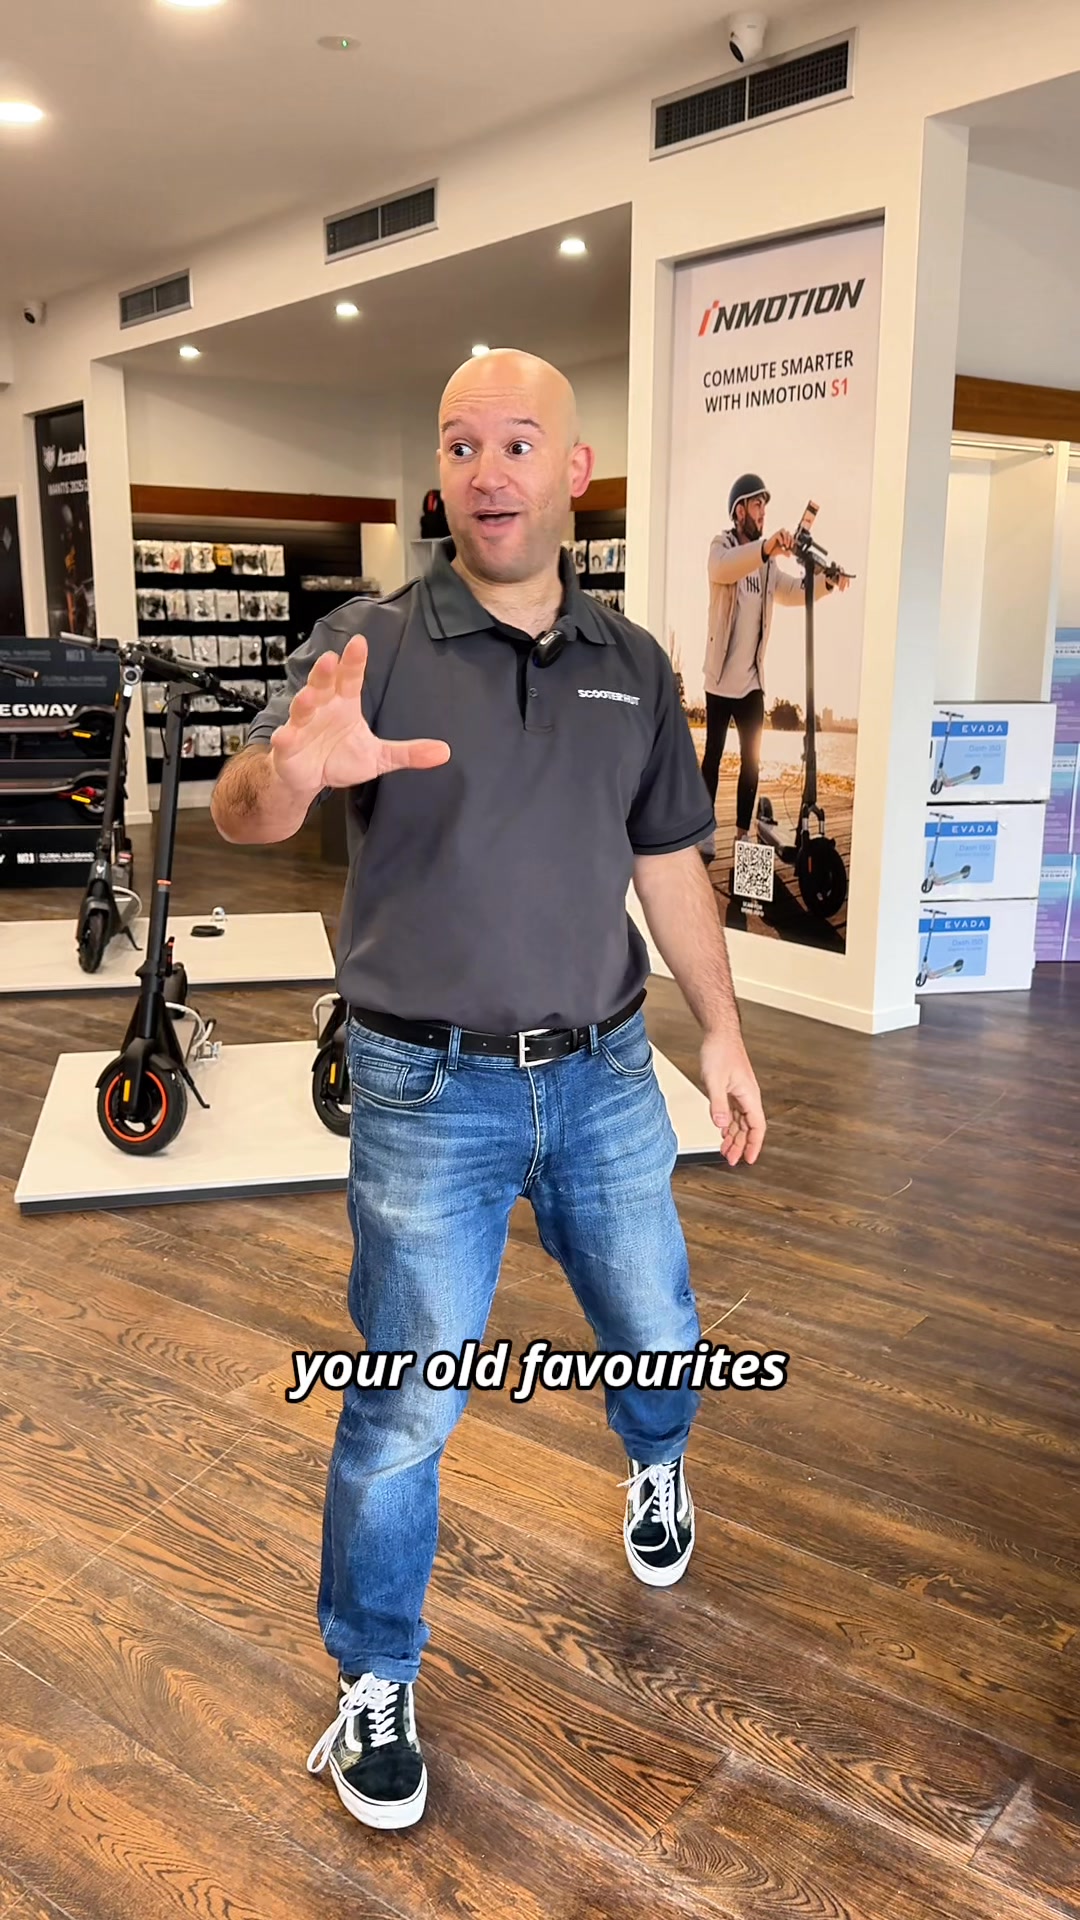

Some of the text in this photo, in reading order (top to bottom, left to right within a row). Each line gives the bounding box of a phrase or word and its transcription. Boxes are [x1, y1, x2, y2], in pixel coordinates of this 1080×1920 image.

[703, 350, 854, 388] COMMUTE SMARTER
[705, 378, 848, 413] WITH INMOTION S1
[961, 724, 1004, 734] EVADA
[951, 825, 993, 834] EVADA
[944, 919, 986, 929] EVADA
